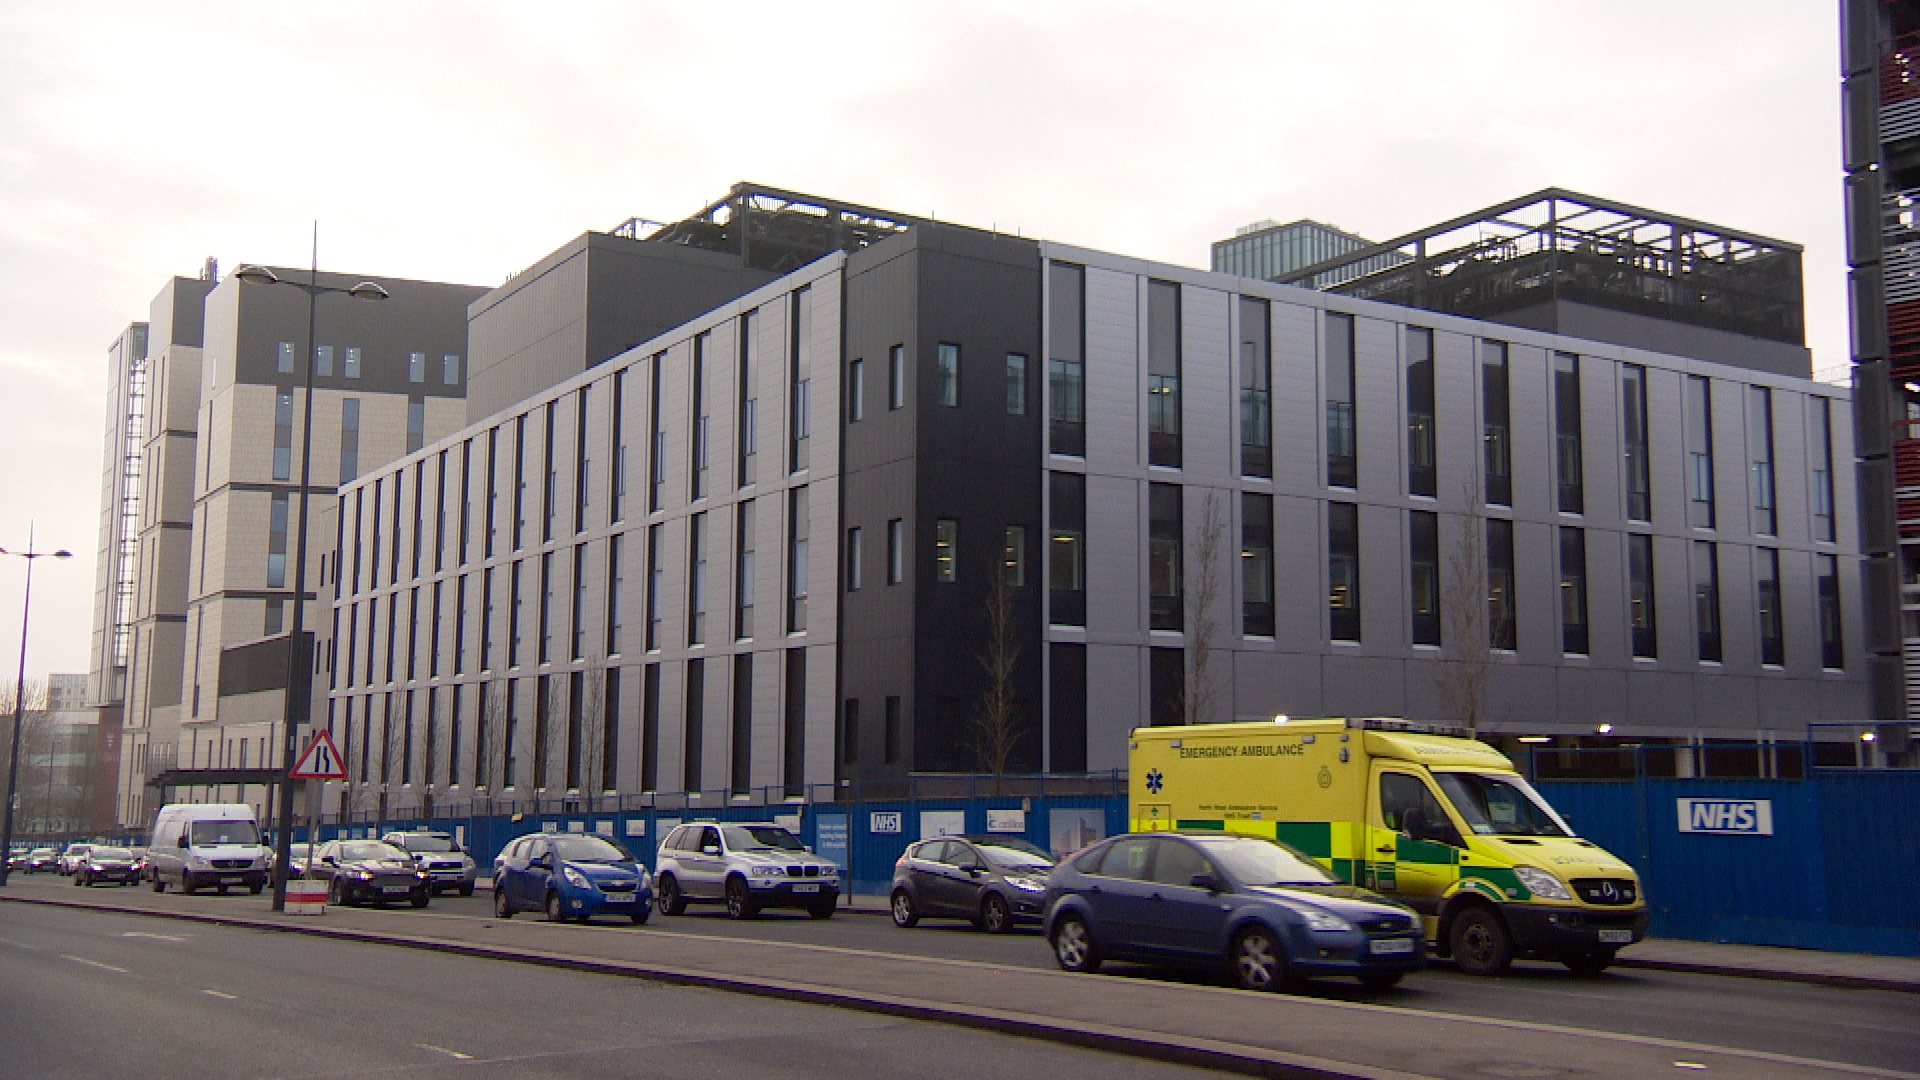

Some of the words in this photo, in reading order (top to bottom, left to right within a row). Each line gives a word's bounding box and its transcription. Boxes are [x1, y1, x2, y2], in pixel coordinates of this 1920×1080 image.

[1180, 746, 1238, 758] EMERGENCY
[1240, 743, 1304, 757] AMBULANCE
[876, 814, 896, 830] NHS
[1693, 803, 1755, 829] NHS
